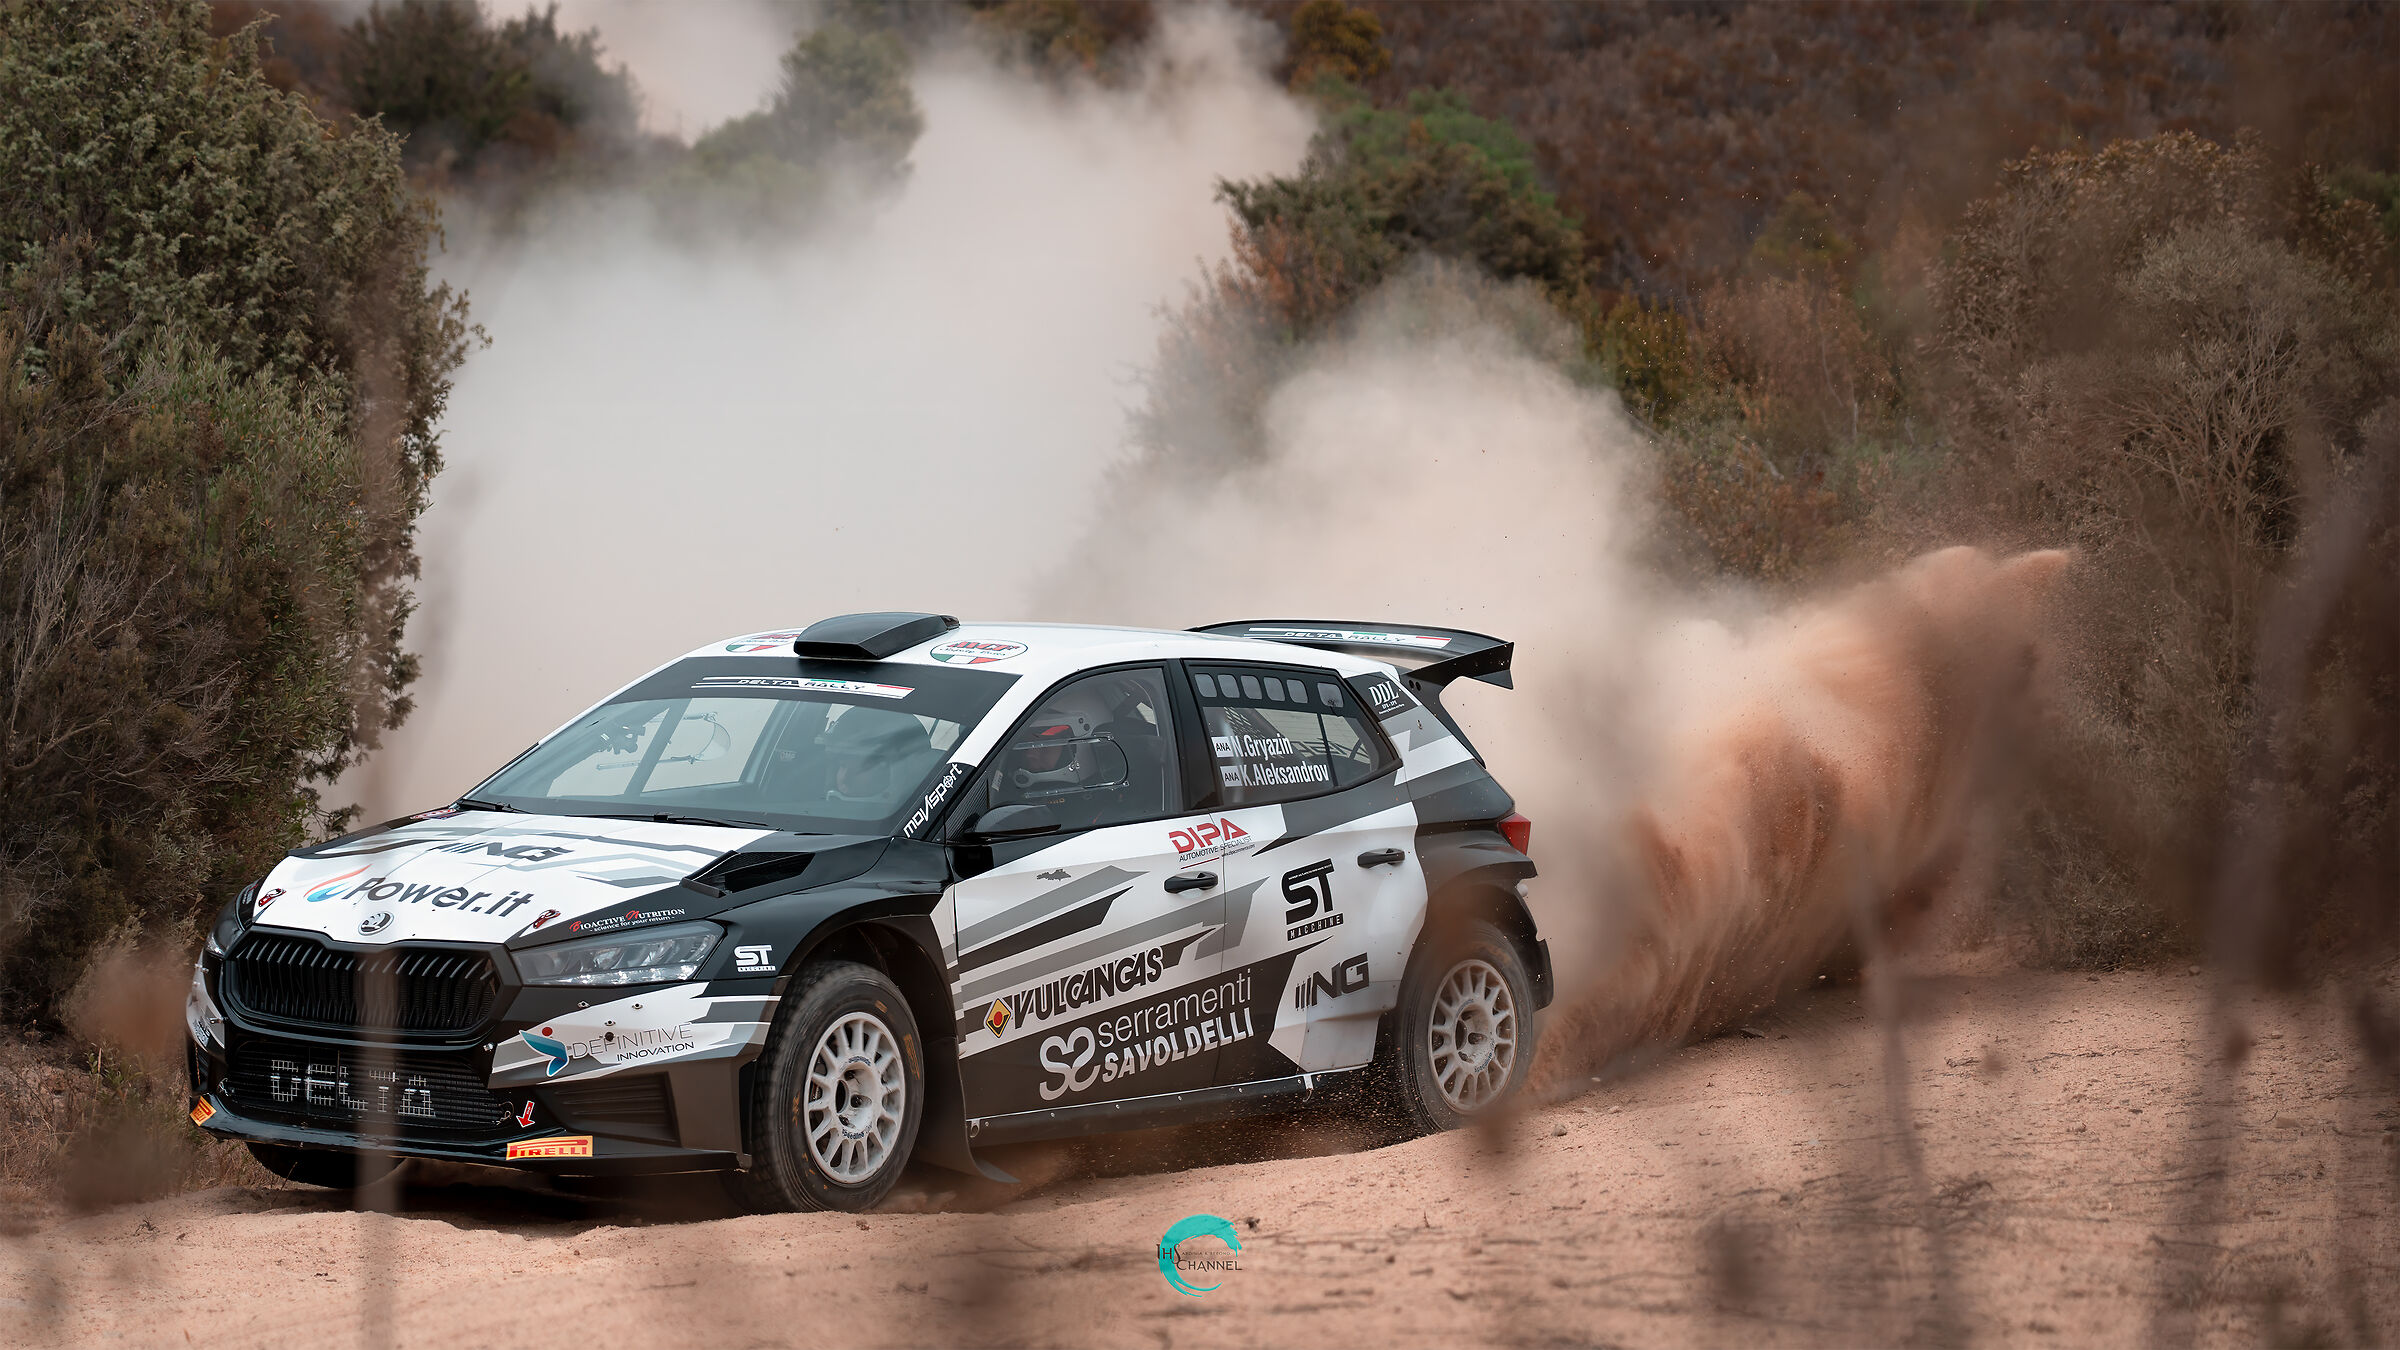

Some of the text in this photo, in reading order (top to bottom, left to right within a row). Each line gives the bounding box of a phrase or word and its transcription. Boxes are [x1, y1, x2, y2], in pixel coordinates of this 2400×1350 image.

[804, 682, 866, 690] RALLY
[1368, 680, 1400, 706] DDL
[1215, 733, 1293, 761] ANA N.Gryazin
[1224, 761, 1330, 787] ANA K.Aleksandrov
[1168, 817, 1249, 854] DIPA
[1179, 845, 1219, 862] AUTOMOTIVE
[342, 877, 534, 917] Power.it
[1281, 858, 1335, 925] ST
[1289, 914, 1341, 939] MACCHINE
[734, 945, 773, 966] ST
[1011, 948, 1162, 1029] VULCANGAS
[1098, 969, 1251, 1048] serramenti
[573, 1024, 693, 1059] DEFINITIVE
[617, 1041, 694, 1062] INNOVATION
[1102, 1008, 1254, 1083] SAVOLDELLI
[271, 1060, 436, 1117] DELTA
[509, 1140, 588, 1157] PIRELLI
